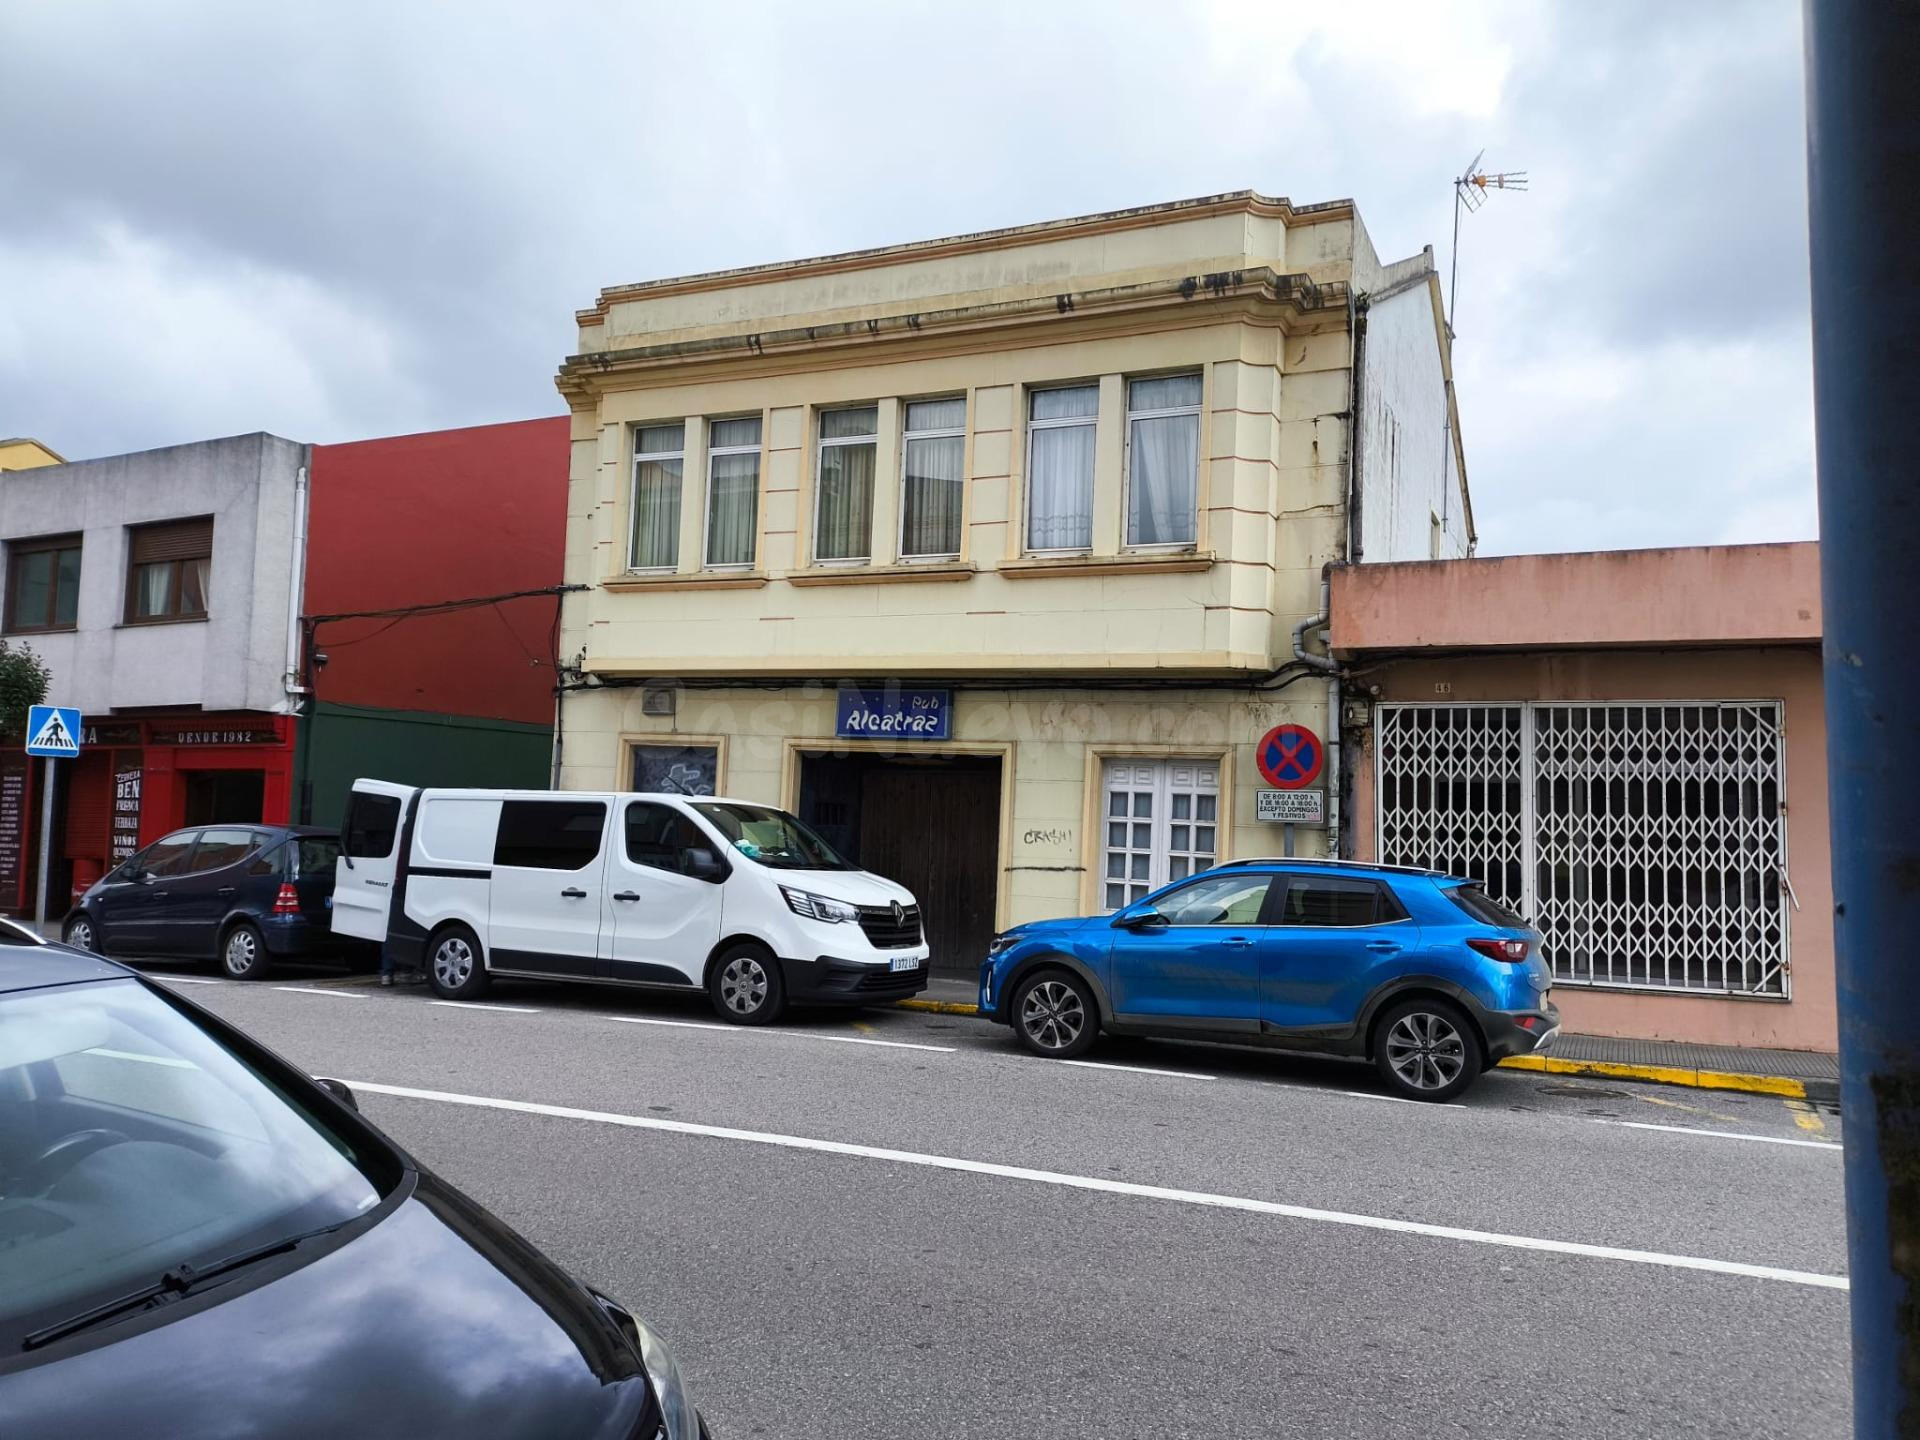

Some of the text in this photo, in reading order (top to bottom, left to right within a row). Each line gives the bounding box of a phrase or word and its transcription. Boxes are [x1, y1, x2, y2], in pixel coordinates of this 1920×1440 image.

[846, 710, 938, 732] Alcatraz
[223, 731, 251, 743] 1982
[117, 780, 139, 798] BEN
